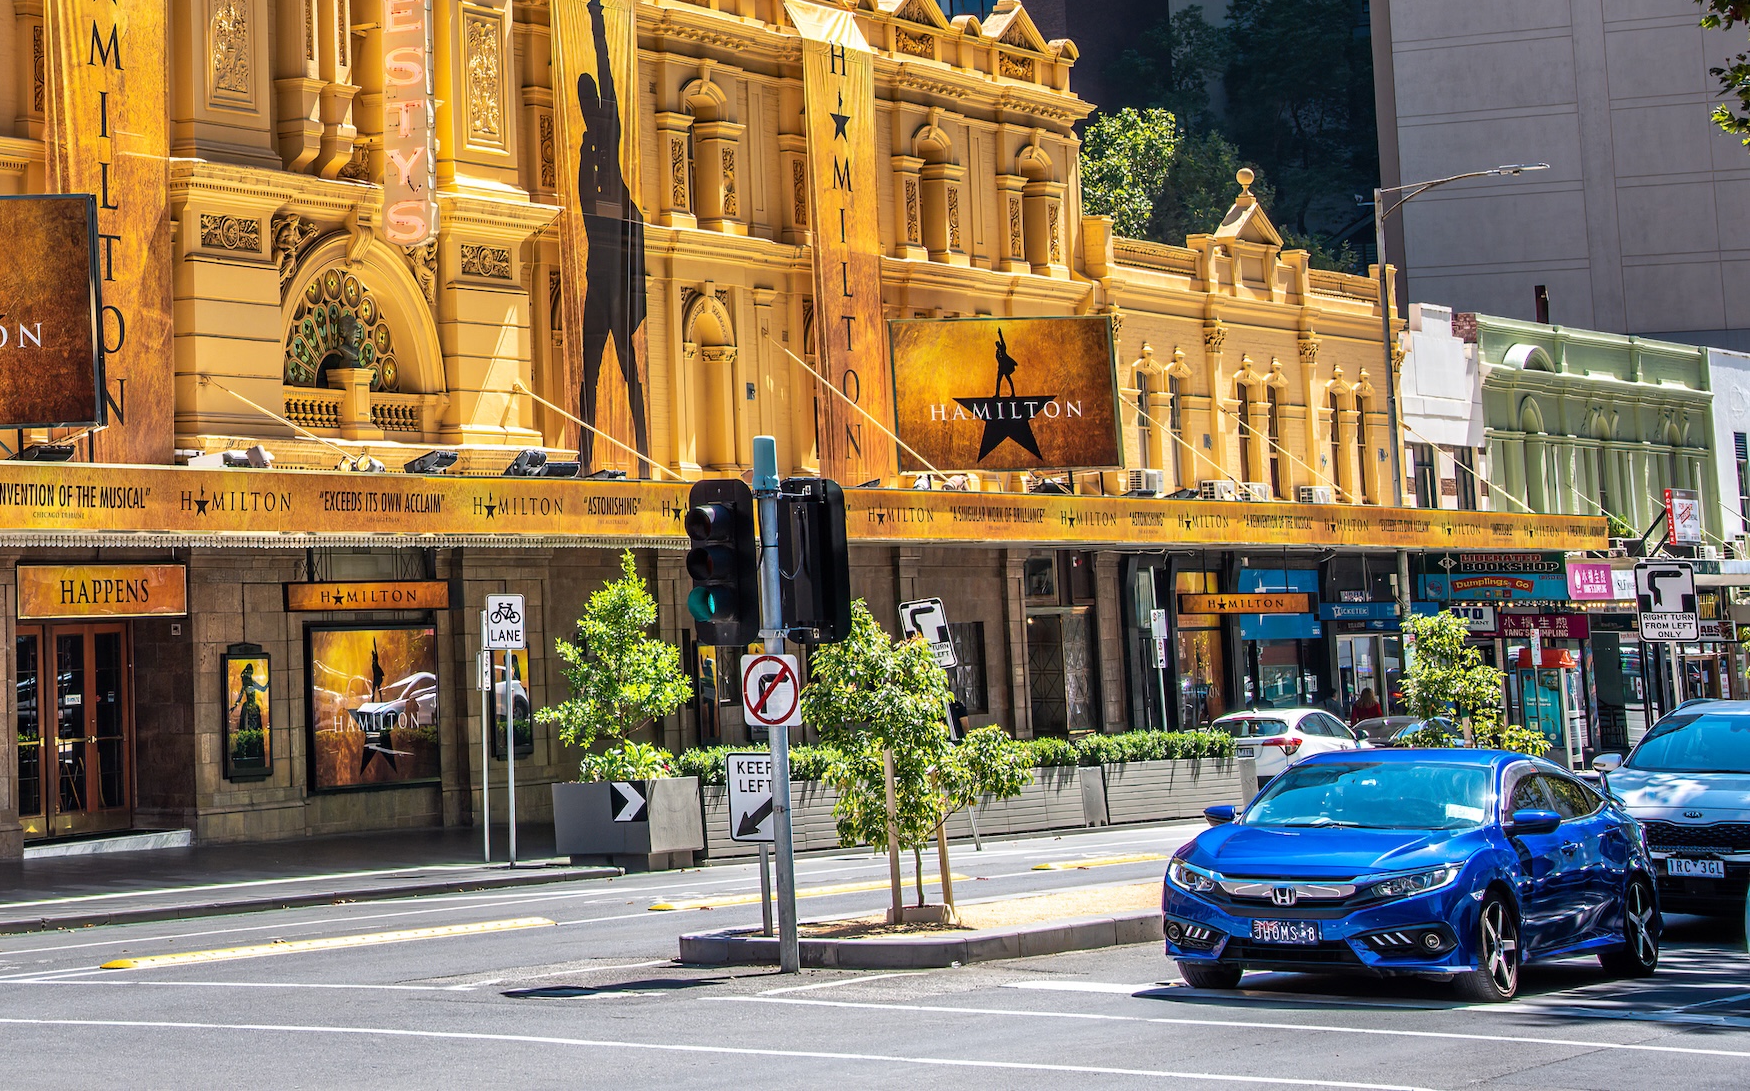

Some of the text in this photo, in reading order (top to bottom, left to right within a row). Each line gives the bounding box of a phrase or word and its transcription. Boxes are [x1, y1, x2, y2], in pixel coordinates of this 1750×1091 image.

[931, 399, 1083, 422] HAMILTON
[58, 484, 73, 507] OF
[76, 485, 97, 508] THE
[99, 486, 151, 510] MUSICAL"
[319, 491, 445, 514] "EXCEEDS ITS OWN ACCLAIM"
[583, 496, 641, 516] "ASTONISHING"
[32, 511, 59, 519] CHICAGO
[1461, 561, 1559, 573] BOOKSHOP
[1455, 576, 1508, 590] Dumplings
[60, 579, 149, 604] HAPPENS
[1643, 613, 1694, 621] RIGHT TURN
[1645, 622, 1693, 630] FROM LEFT
[490, 629, 521, 642] LANE
[1539, 629, 1569, 637] UMPLING
[333, 711, 420, 733] HAMILTON
[739, 780, 772, 793] LEFT
